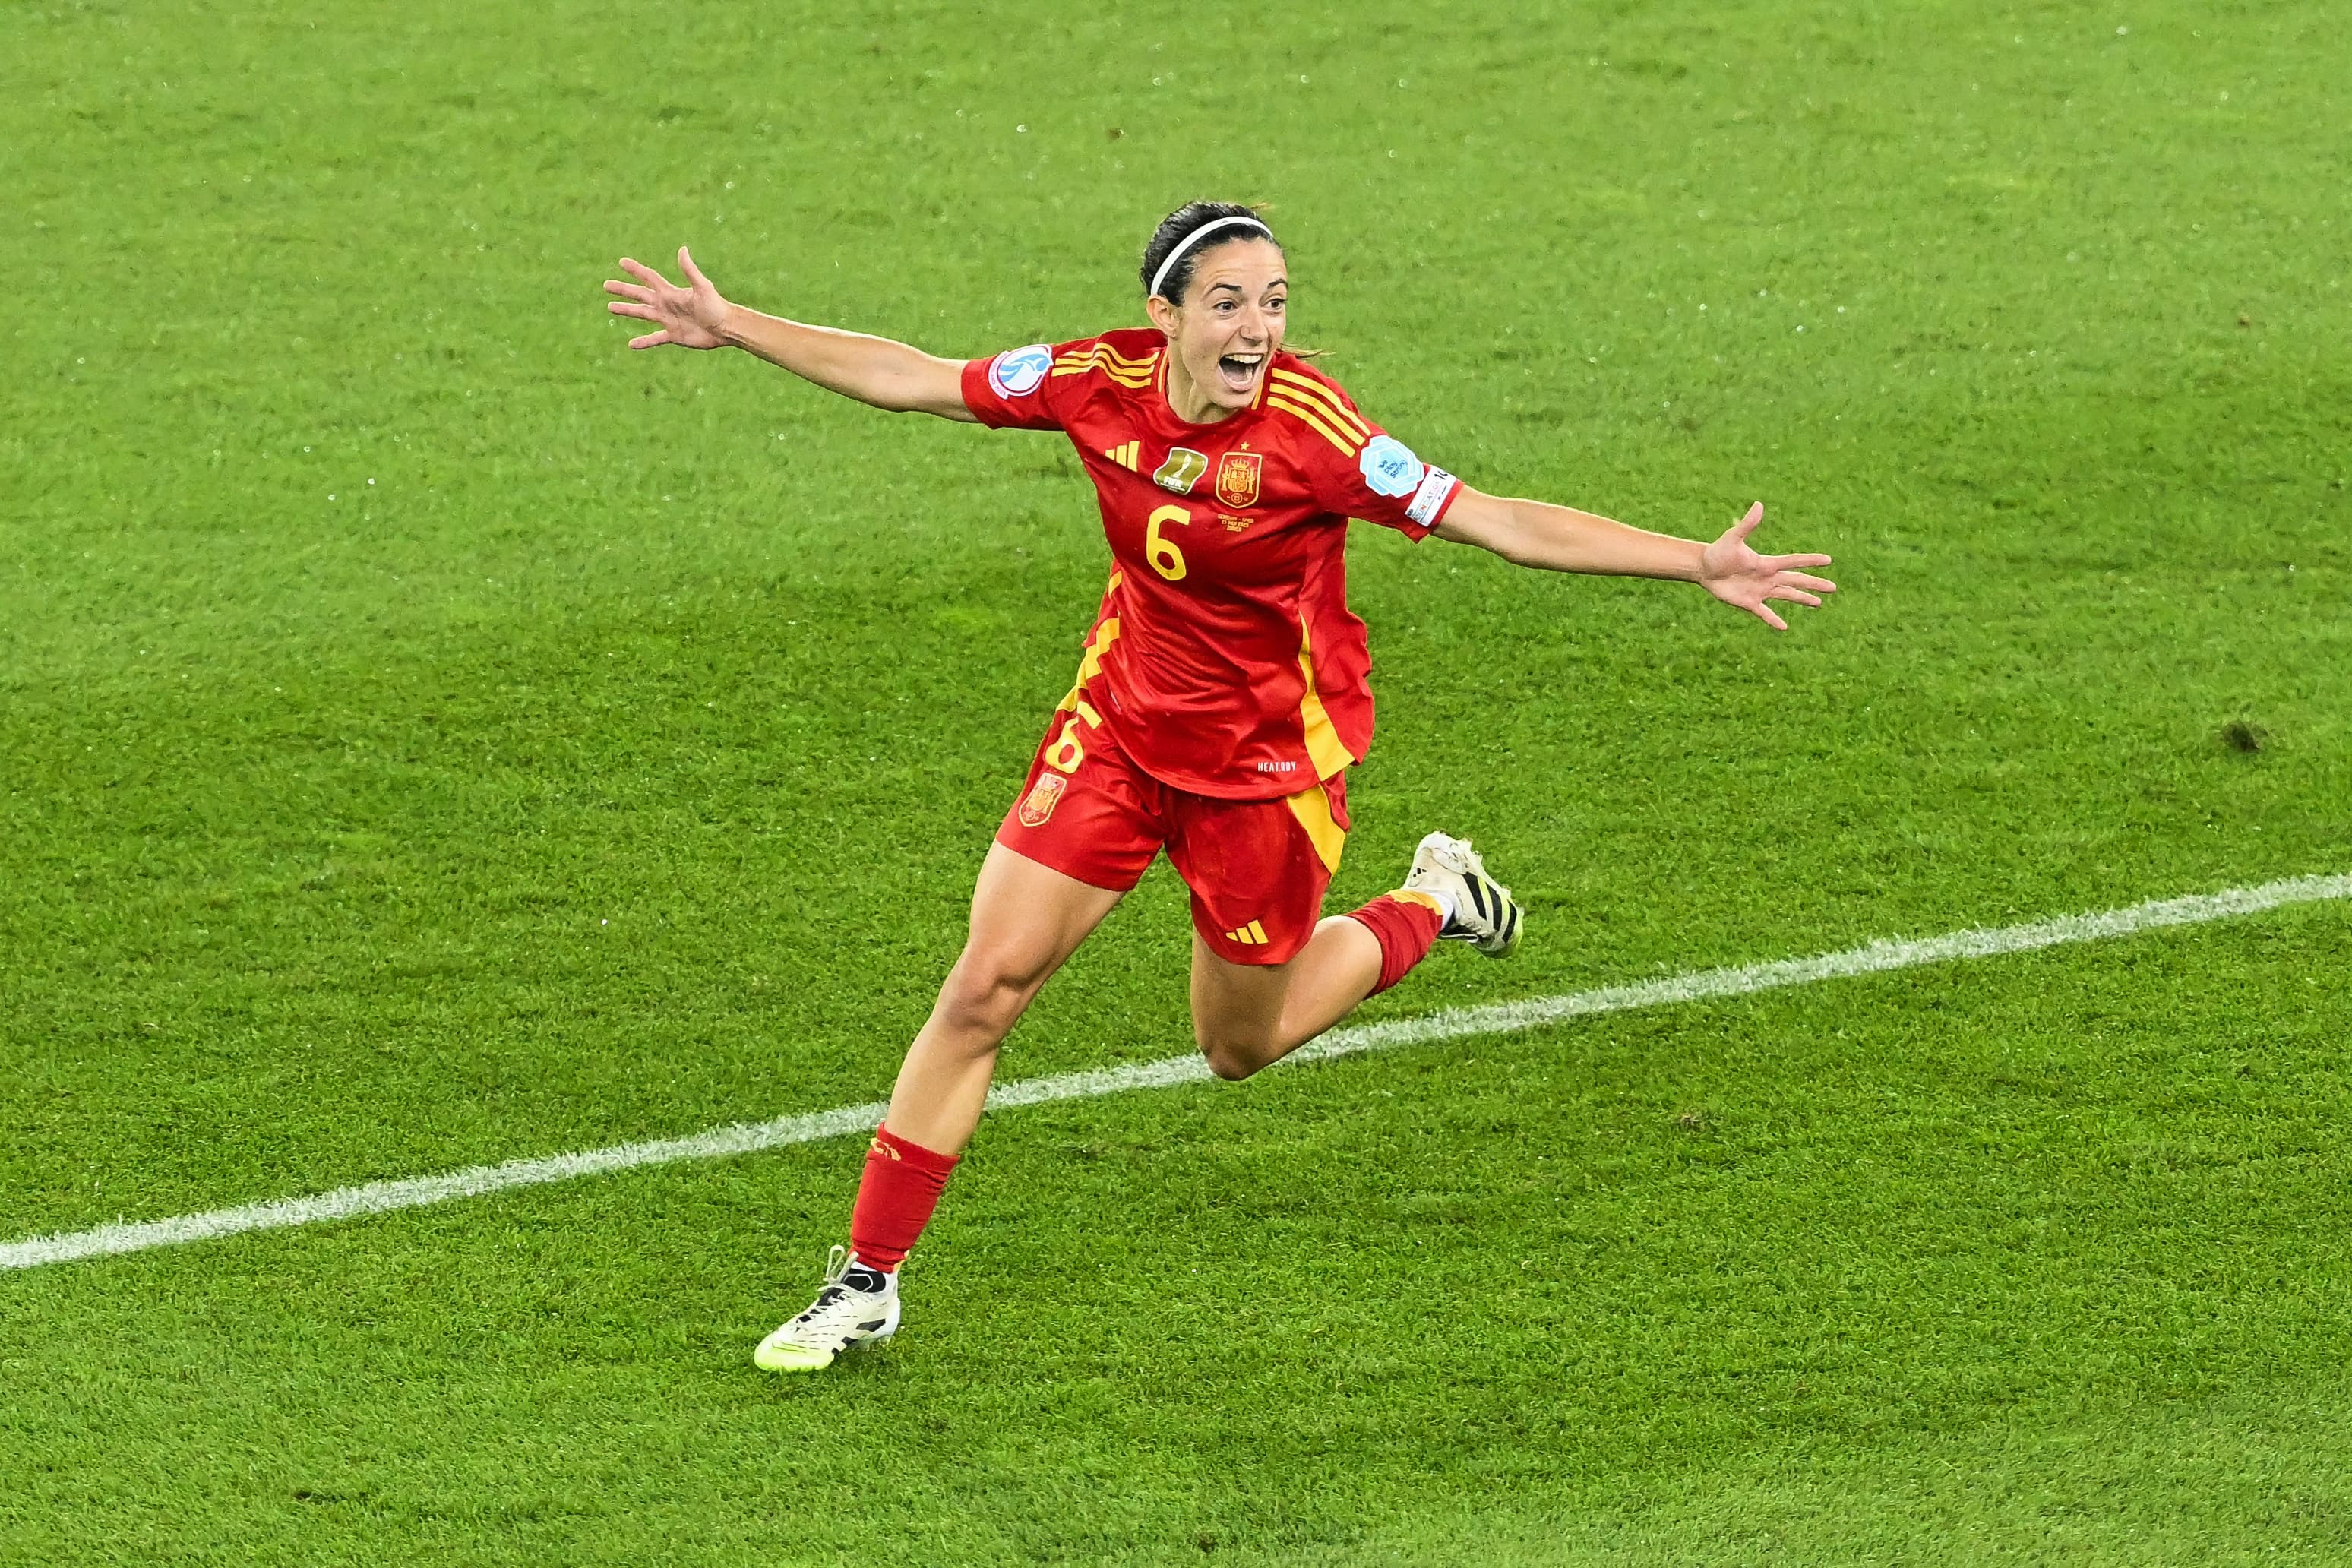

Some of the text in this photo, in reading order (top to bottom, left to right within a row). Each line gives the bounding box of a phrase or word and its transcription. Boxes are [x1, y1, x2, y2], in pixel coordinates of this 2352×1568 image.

[1384, 461, 1398, 474] play
[1390, 459, 1408, 479] strong
[1163, 476, 1184, 488] FIFA
[1146, 504, 1191, 580] 6
[1045, 700, 1102, 774] 6
